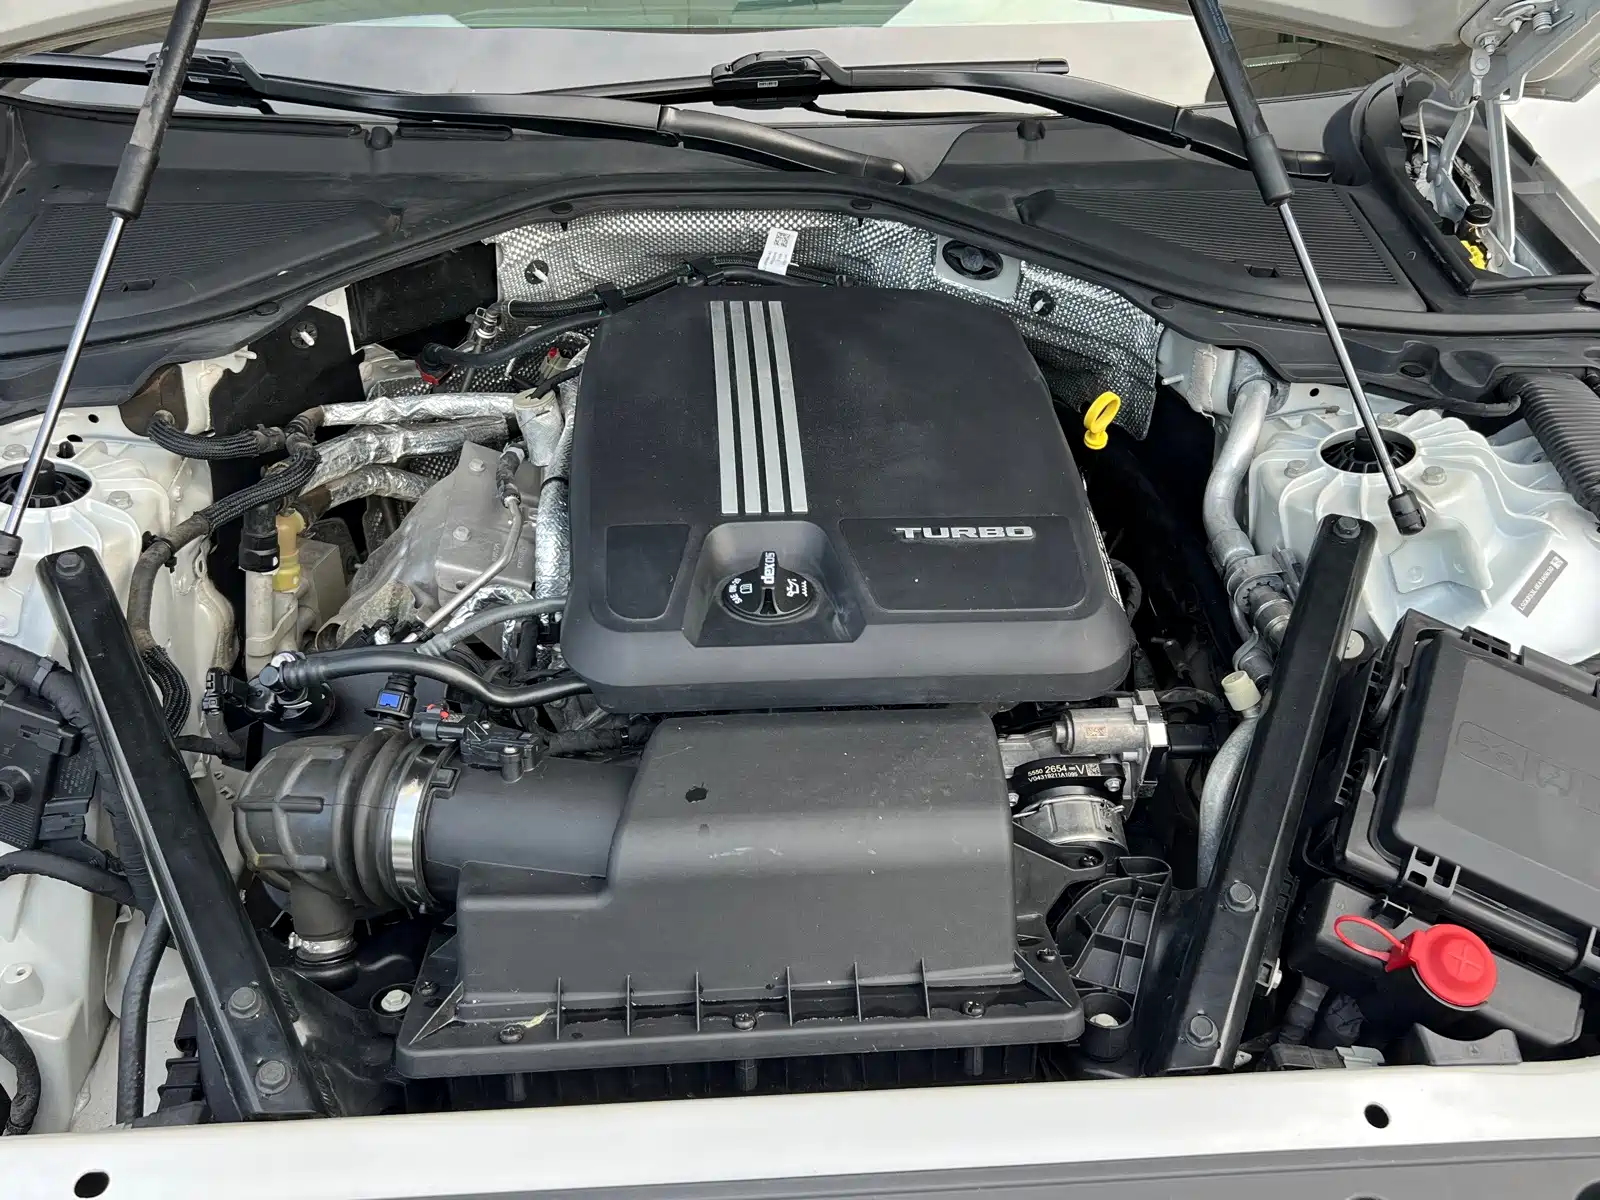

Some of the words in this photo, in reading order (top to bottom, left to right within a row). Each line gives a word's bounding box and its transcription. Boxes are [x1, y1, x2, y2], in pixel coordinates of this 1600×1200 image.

[895, 526, 1034, 539] TURBO
[761, 552, 775, 584] dexos
[1044, 764, 1067, 774] 2654
